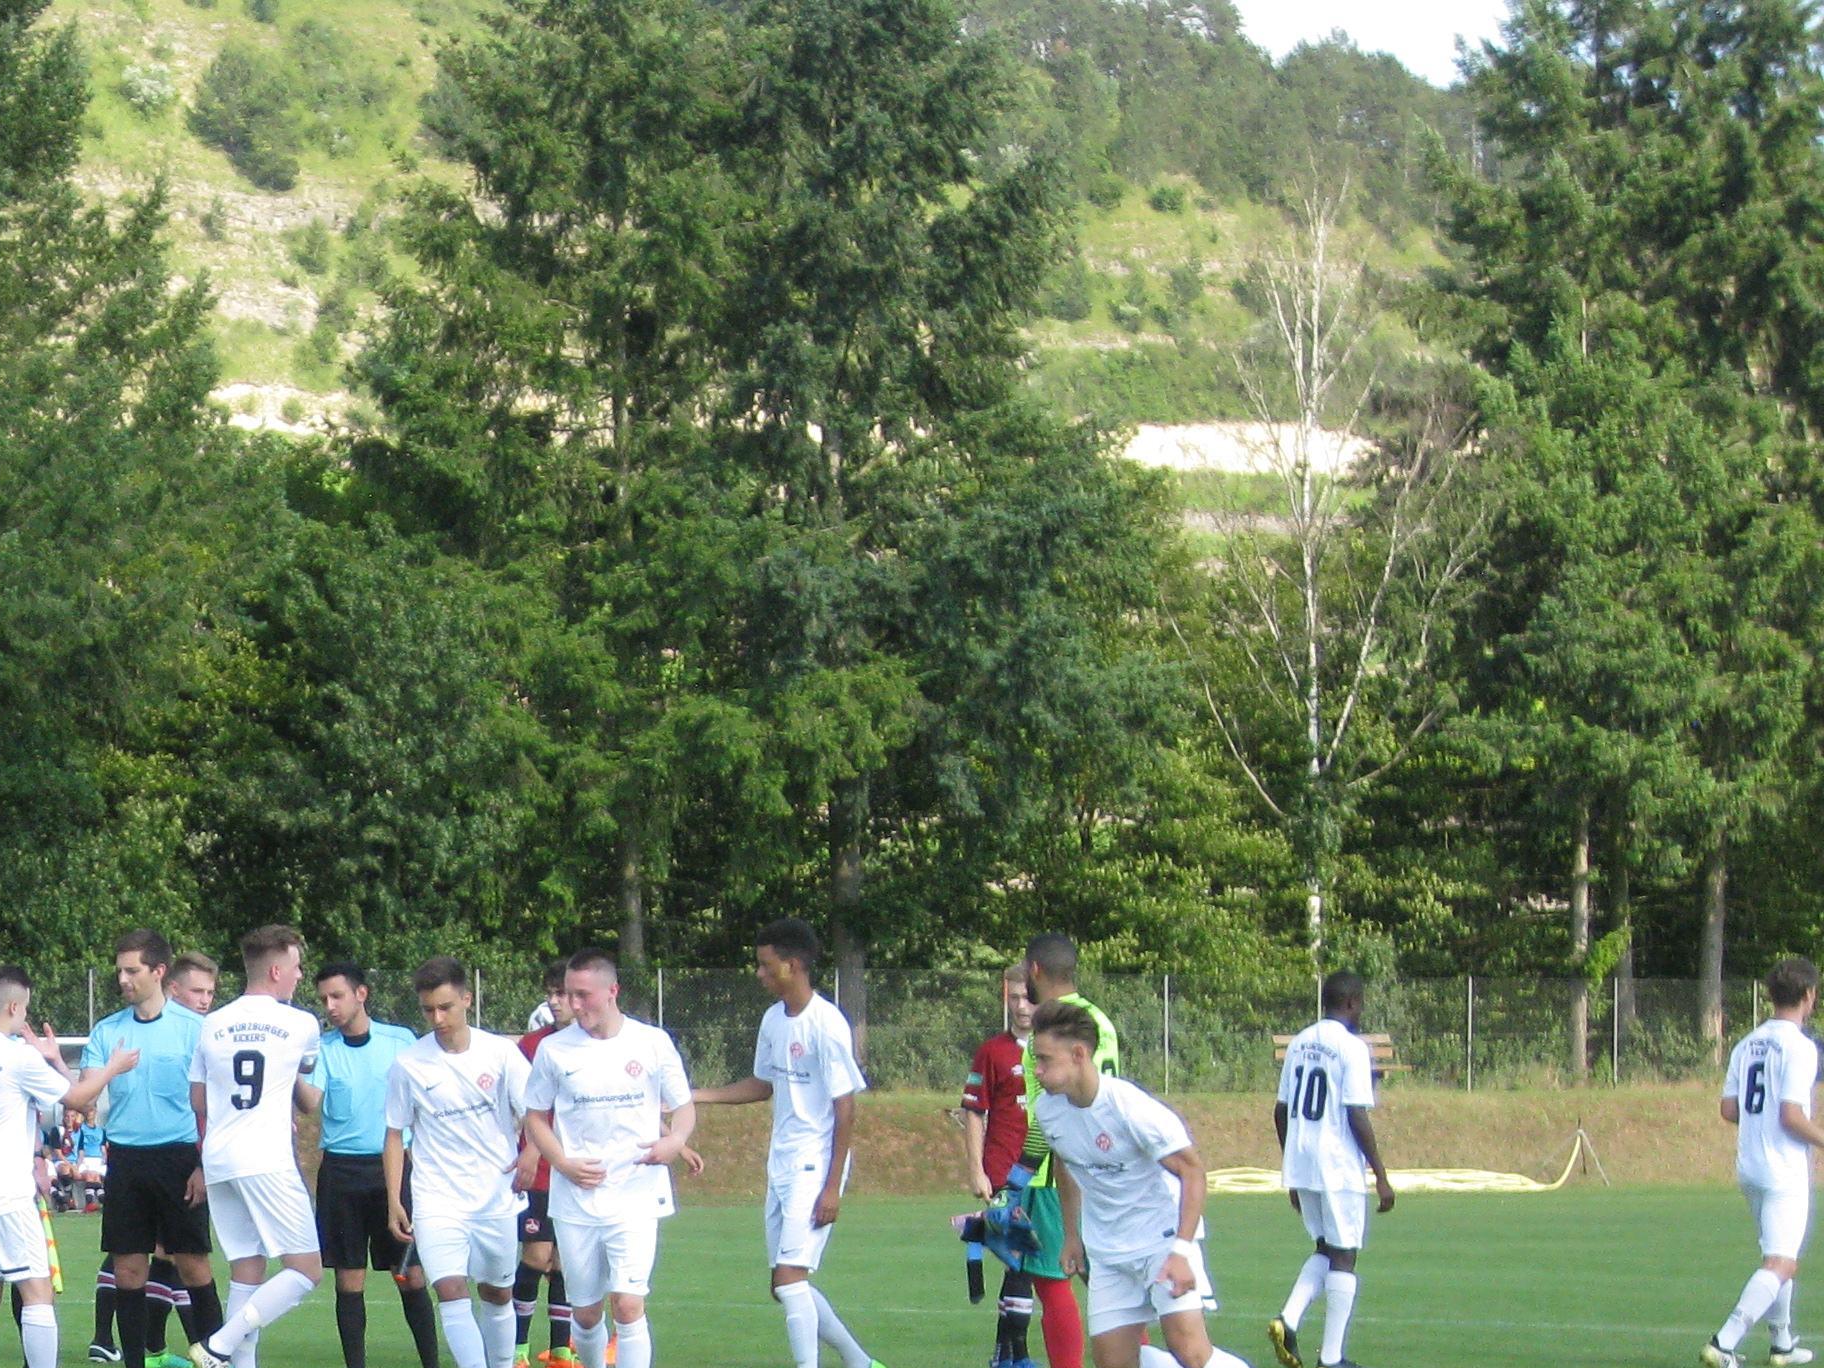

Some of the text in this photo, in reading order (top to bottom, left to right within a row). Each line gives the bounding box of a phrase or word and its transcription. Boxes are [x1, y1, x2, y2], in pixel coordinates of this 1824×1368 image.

[231, 1050, 265, 1110] 9
[1291, 1066, 1327, 1121] 10
[1745, 1062, 1765, 1114] 6
